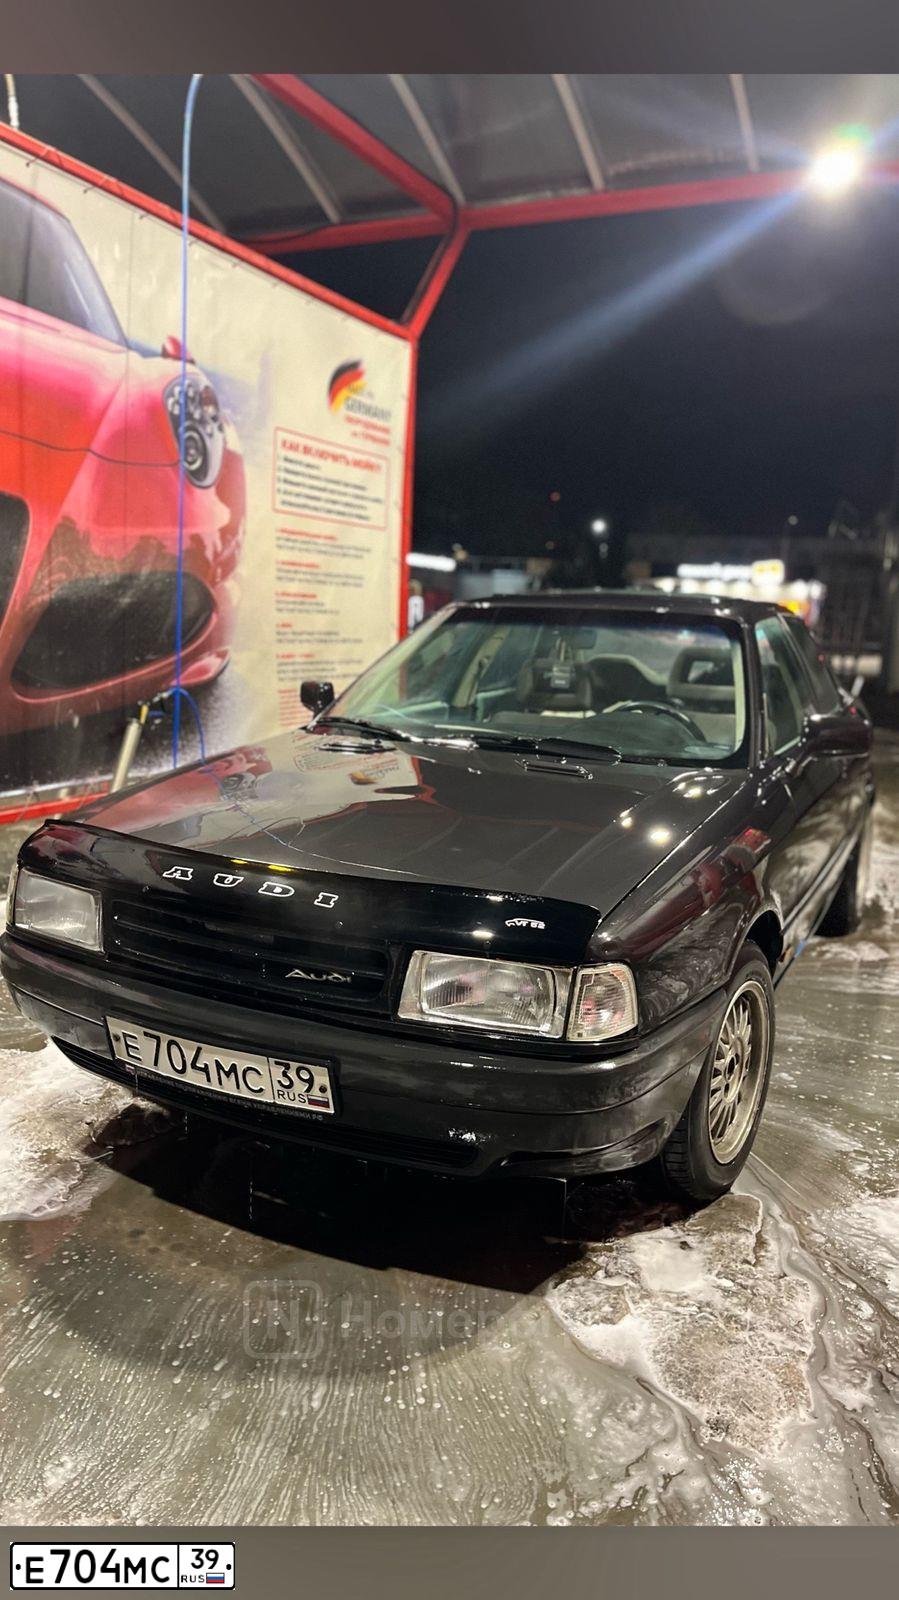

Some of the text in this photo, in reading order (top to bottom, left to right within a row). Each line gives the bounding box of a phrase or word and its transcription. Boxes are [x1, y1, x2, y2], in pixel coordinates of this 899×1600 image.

[163, 866, 339, 908] AUDI
[285, 968, 351, 983] Audi
[121, 1030, 265, 1093] Е704МС
[273, 1060, 315, 1093] 39
[276, 1089, 307, 1103] RUS
